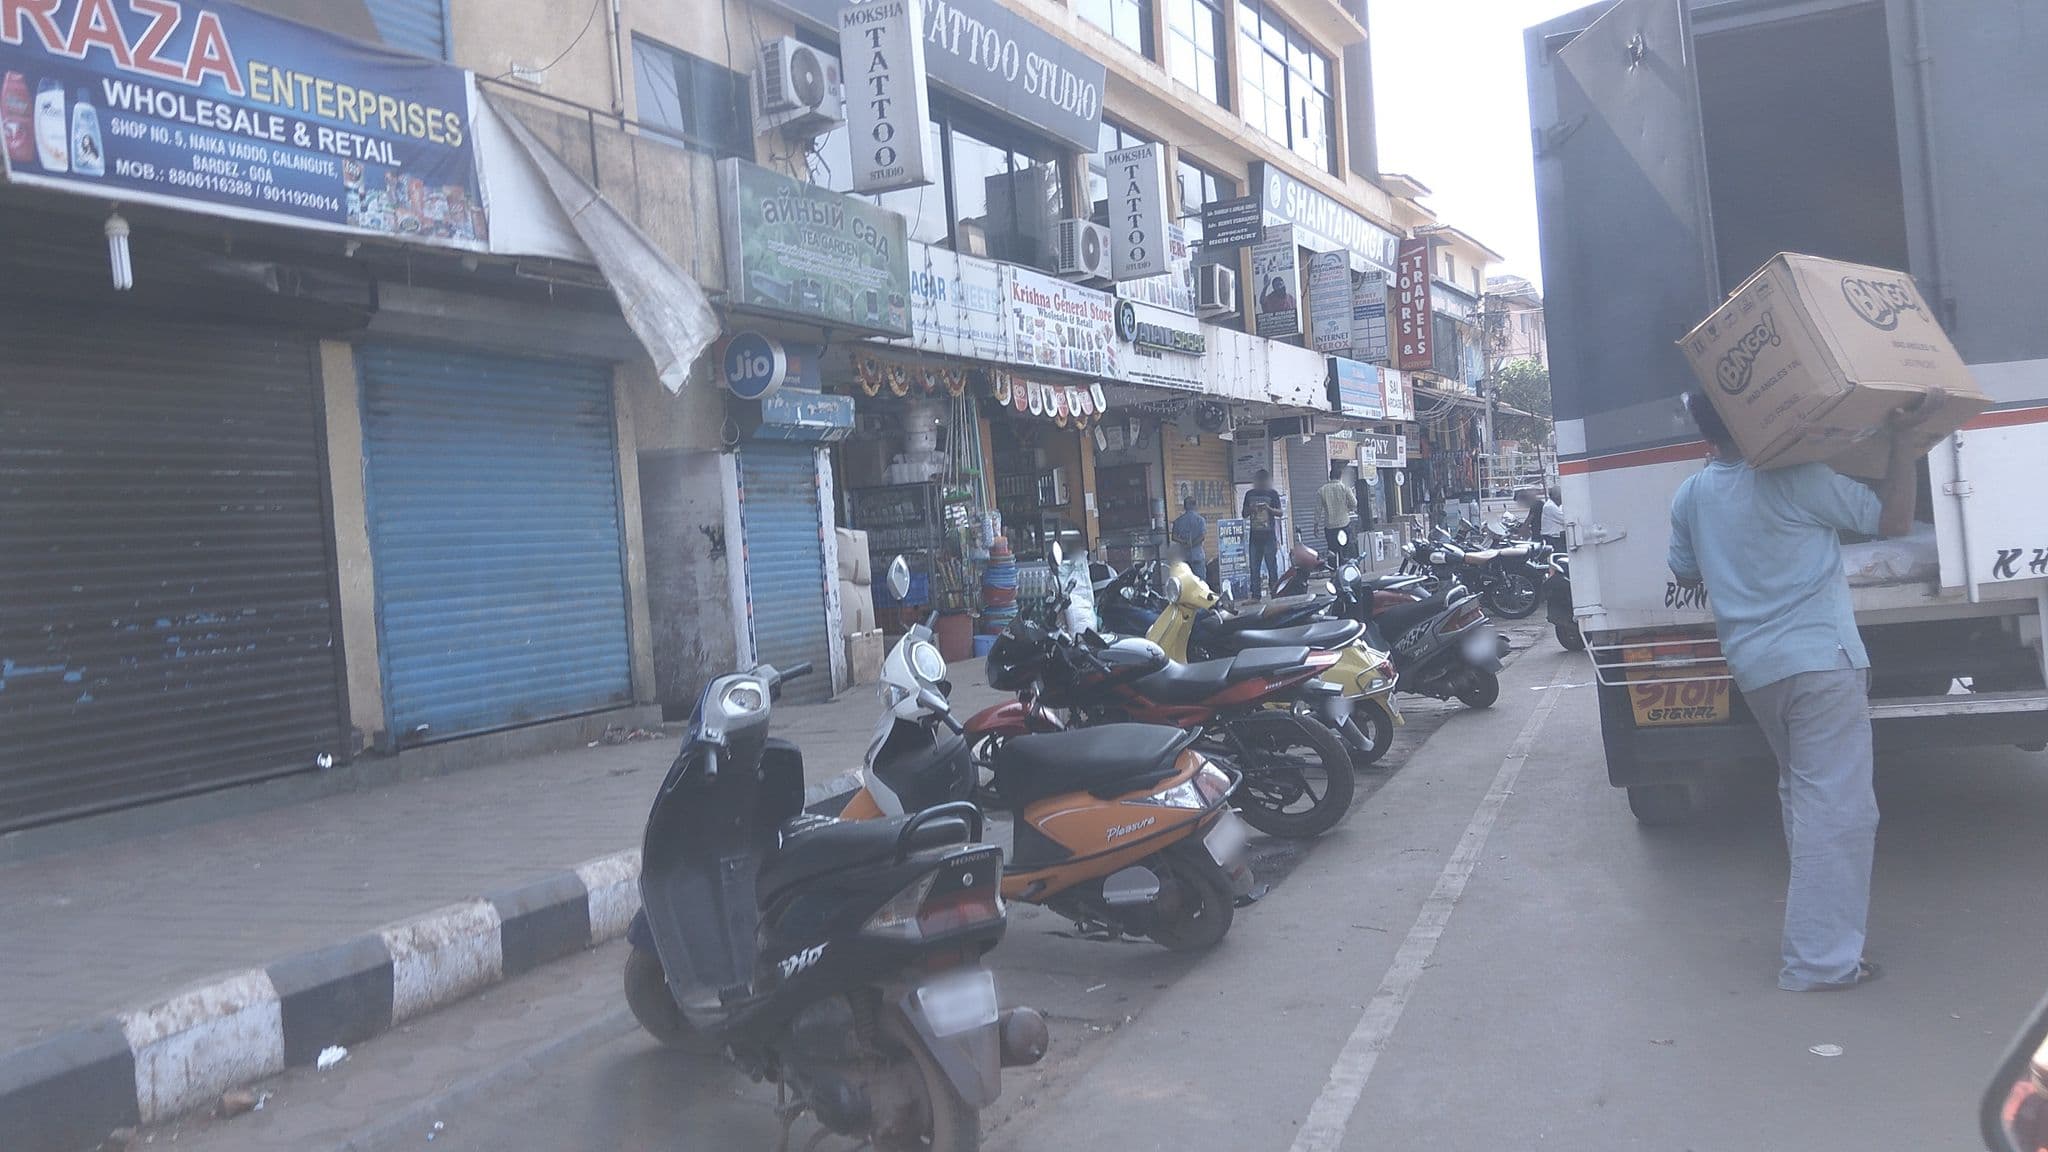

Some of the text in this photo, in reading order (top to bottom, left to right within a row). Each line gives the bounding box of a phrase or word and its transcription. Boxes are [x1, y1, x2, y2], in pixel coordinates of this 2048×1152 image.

[843, 2, 903, 28] MOKSHA
[0, 0, 463, 147] RAZA ENTERPRISES
[1024, 51, 1097, 121] STUDIO
[864, 26, 897, 168] TATTOO
[102, 78, 402, 166] WHOLESALE & RETAIL
[111, 117, 147, 139] SHOP
[150, 125, 172, 145] NO.
[189, 133, 225, 155] NAIKA
[228, 141, 271, 166] VADDO,
[272, 153, 339, 179] CALANGUTE,
[1108, 148, 1152, 166] MOKSHA
[193, 155, 239, 178] BARDEZ
[249, 165, 273, 184] GOA
[869, 166, 904, 182] STUDIO
[1124, 164, 1146, 262] TATTOO
[1286, 181, 1385, 263] SHANTADURGA
[911, 270, 946, 301] AGAR
[1012, 281, 1051, 309] Krishna
[1054, 292, 1088, 318] General
[1090, 302, 1113, 324] Store
[1413, 255, 1426, 354] TRAVELS
[1400, 261, 1413, 355] TOURS &
[730, 350, 770, 382] Jio
[1636, 671, 1729, 710] STOP
[1648, 705, 1717, 721] SIGNAL
[1106, 815, 1155, 843] Pleasure
[950, 851, 991, 867] HONDA
